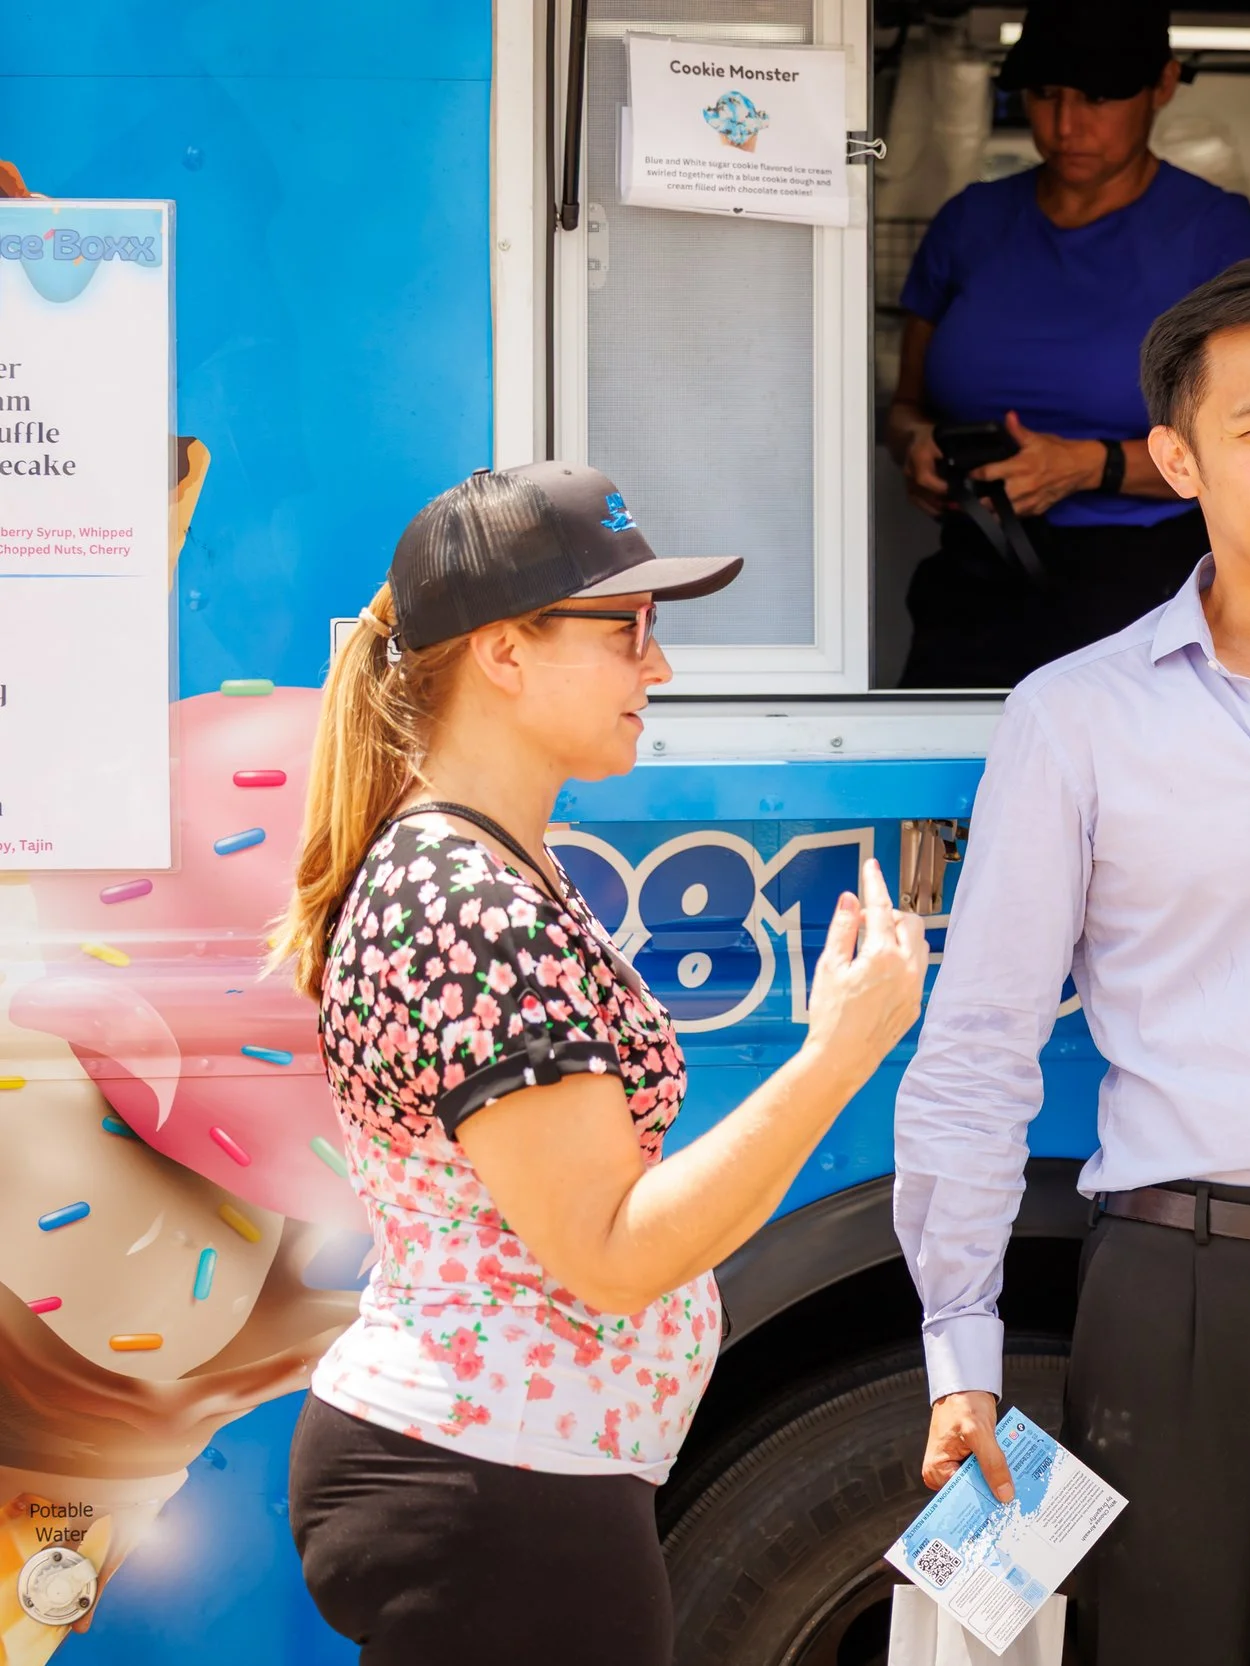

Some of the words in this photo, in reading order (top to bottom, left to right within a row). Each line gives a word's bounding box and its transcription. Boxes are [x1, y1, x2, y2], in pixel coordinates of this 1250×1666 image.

[670, 60, 725, 77] Cookie
[729, 65, 800, 82] Monster
[644, 156, 663, 165] Blue
[665, 158, 681, 166] and
[682, 158, 707, 167] White
[708, 161, 730, 170] sugar
[732, 162, 759, 170] cookie
[760, 163, 793, 172] flavored
[647, 169, 677, 177] swirled
[679, 171, 714, 180] together
[716, 172, 734, 180] with
[762, 175, 787, 183] cookie
[789, 177, 815, 186] dough
[695, 183, 716, 192] filled
[718, 185, 736, 193] with
[738, 186, 778, 195] chocolate
[53, 229, 156, 261] Boxx
[37, 527, 76, 540] Syrup,
[79, 527, 133, 540] Whipped
[54, 544, 86, 557] Nuts,
[89, 544, 130, 557] Cherry
[19, 839, 54, 853] Tajin
[30, 1502, 94, 1518] Potable
[1106, 1498, 1118, 1510] Why
[1094, 1508, 1109, 1525] Choose
[35, 1527, 88, 1542] Water
[1080, 1523, 1096, 1542] Airwash
